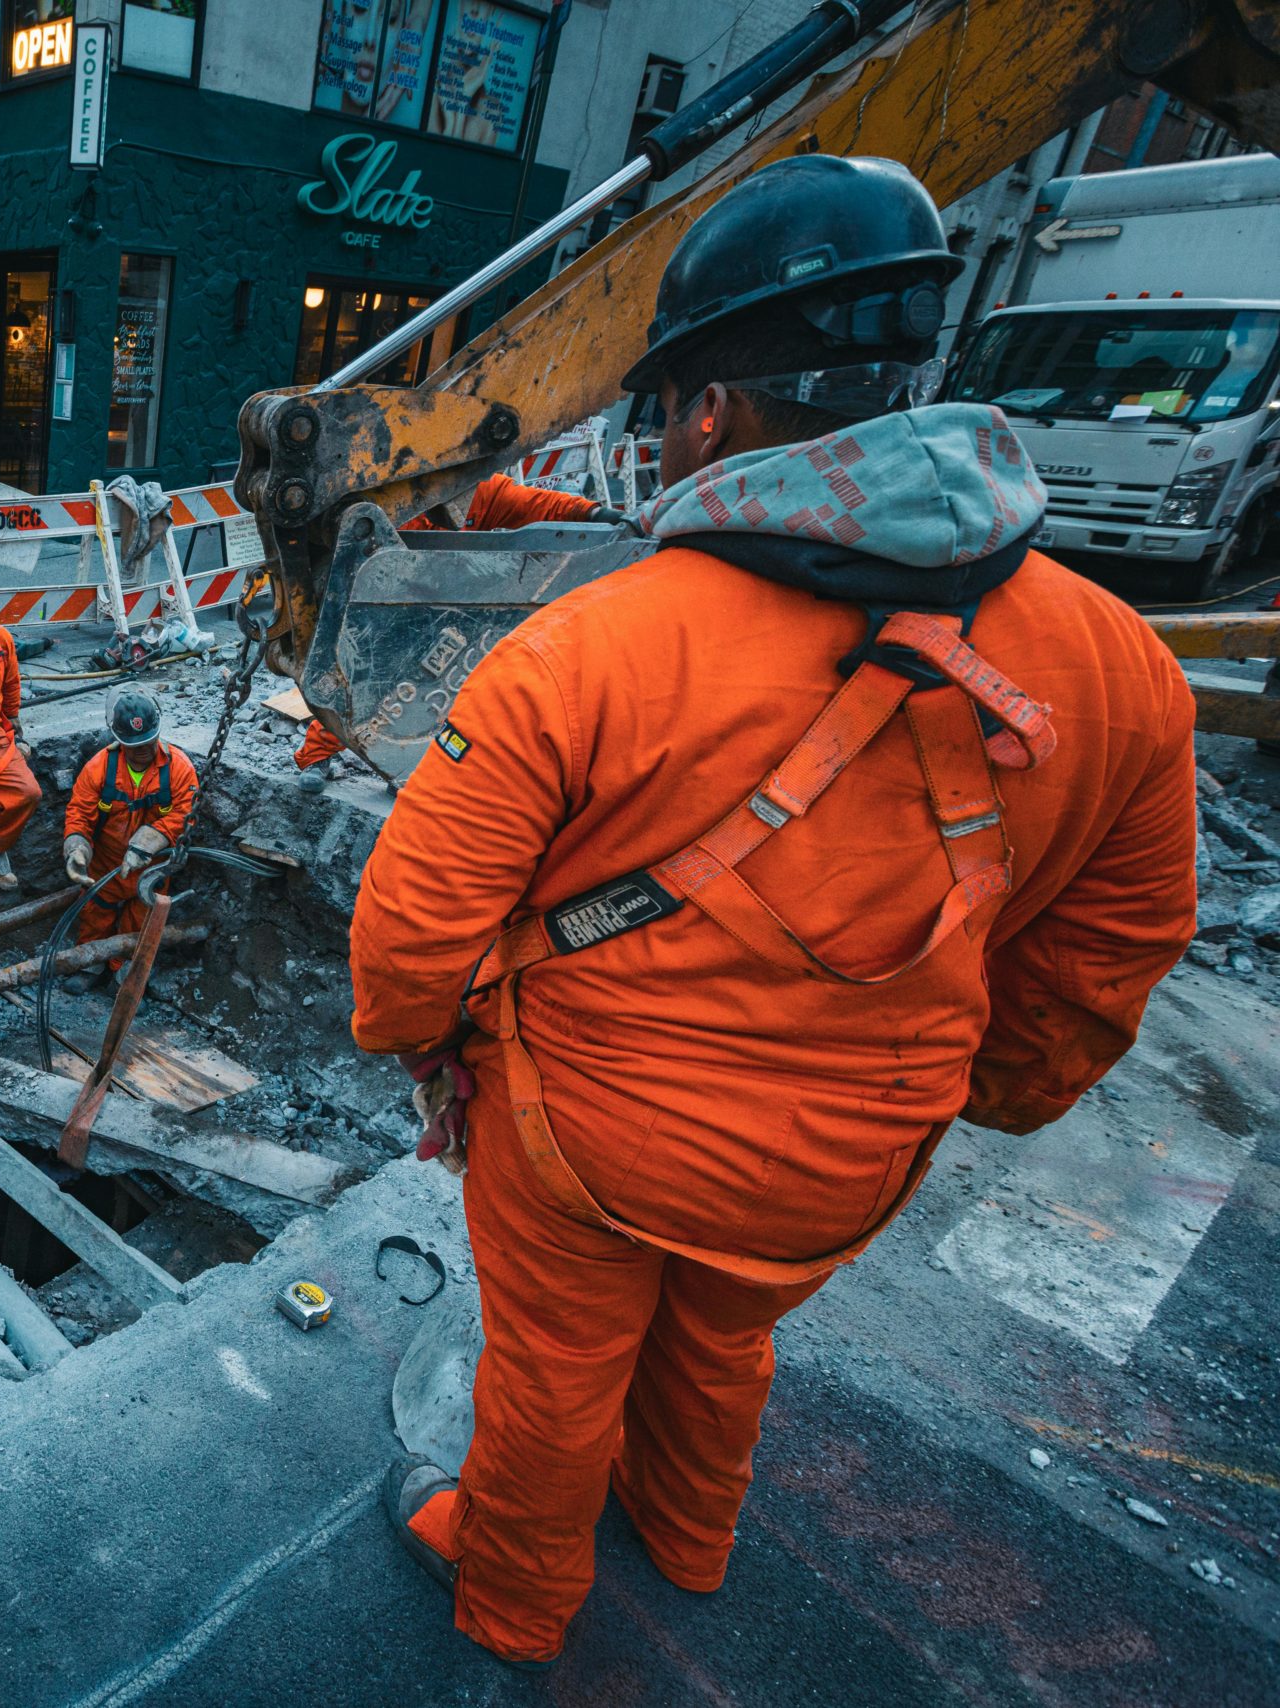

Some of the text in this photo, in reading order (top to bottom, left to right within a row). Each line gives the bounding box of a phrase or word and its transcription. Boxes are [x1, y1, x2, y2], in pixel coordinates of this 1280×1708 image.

[333, 10, 354, 28] Facial
[462, 13, 524, 47] Special Treatment
[14, 22, 72, 71] OPEN
[330, 32, 362, 54] Massage
[401, 29, 421, 46] OPEN
[325, 52, 358, 76] Cupping
[401, 51, 420, 68] DAYS
[322, 72, 367, 98] Reflexology
[397, 71, 419, 90] WEEK
[80, 38, 97, 153] COFFEE
[297, 132, 434, 229] Slate
[344, 231, 381, 249] CAFE
[789, 258, 825, 277] MSA
[121, 310, 154, 322] COFFEE
[911, 305, 938, 319] MSA
[116, 365, 157, 376] SMALL PLATES
[1034, 464, 1093, 476] SUZU
[822, 466, 868, 511] PUMA
[696, 485, 732, 528] PUMA
[557, 898, 612, 931] SAFETY
[618, 894, 650, 916] GWP
[562, 909, 629, 949] PALMER
